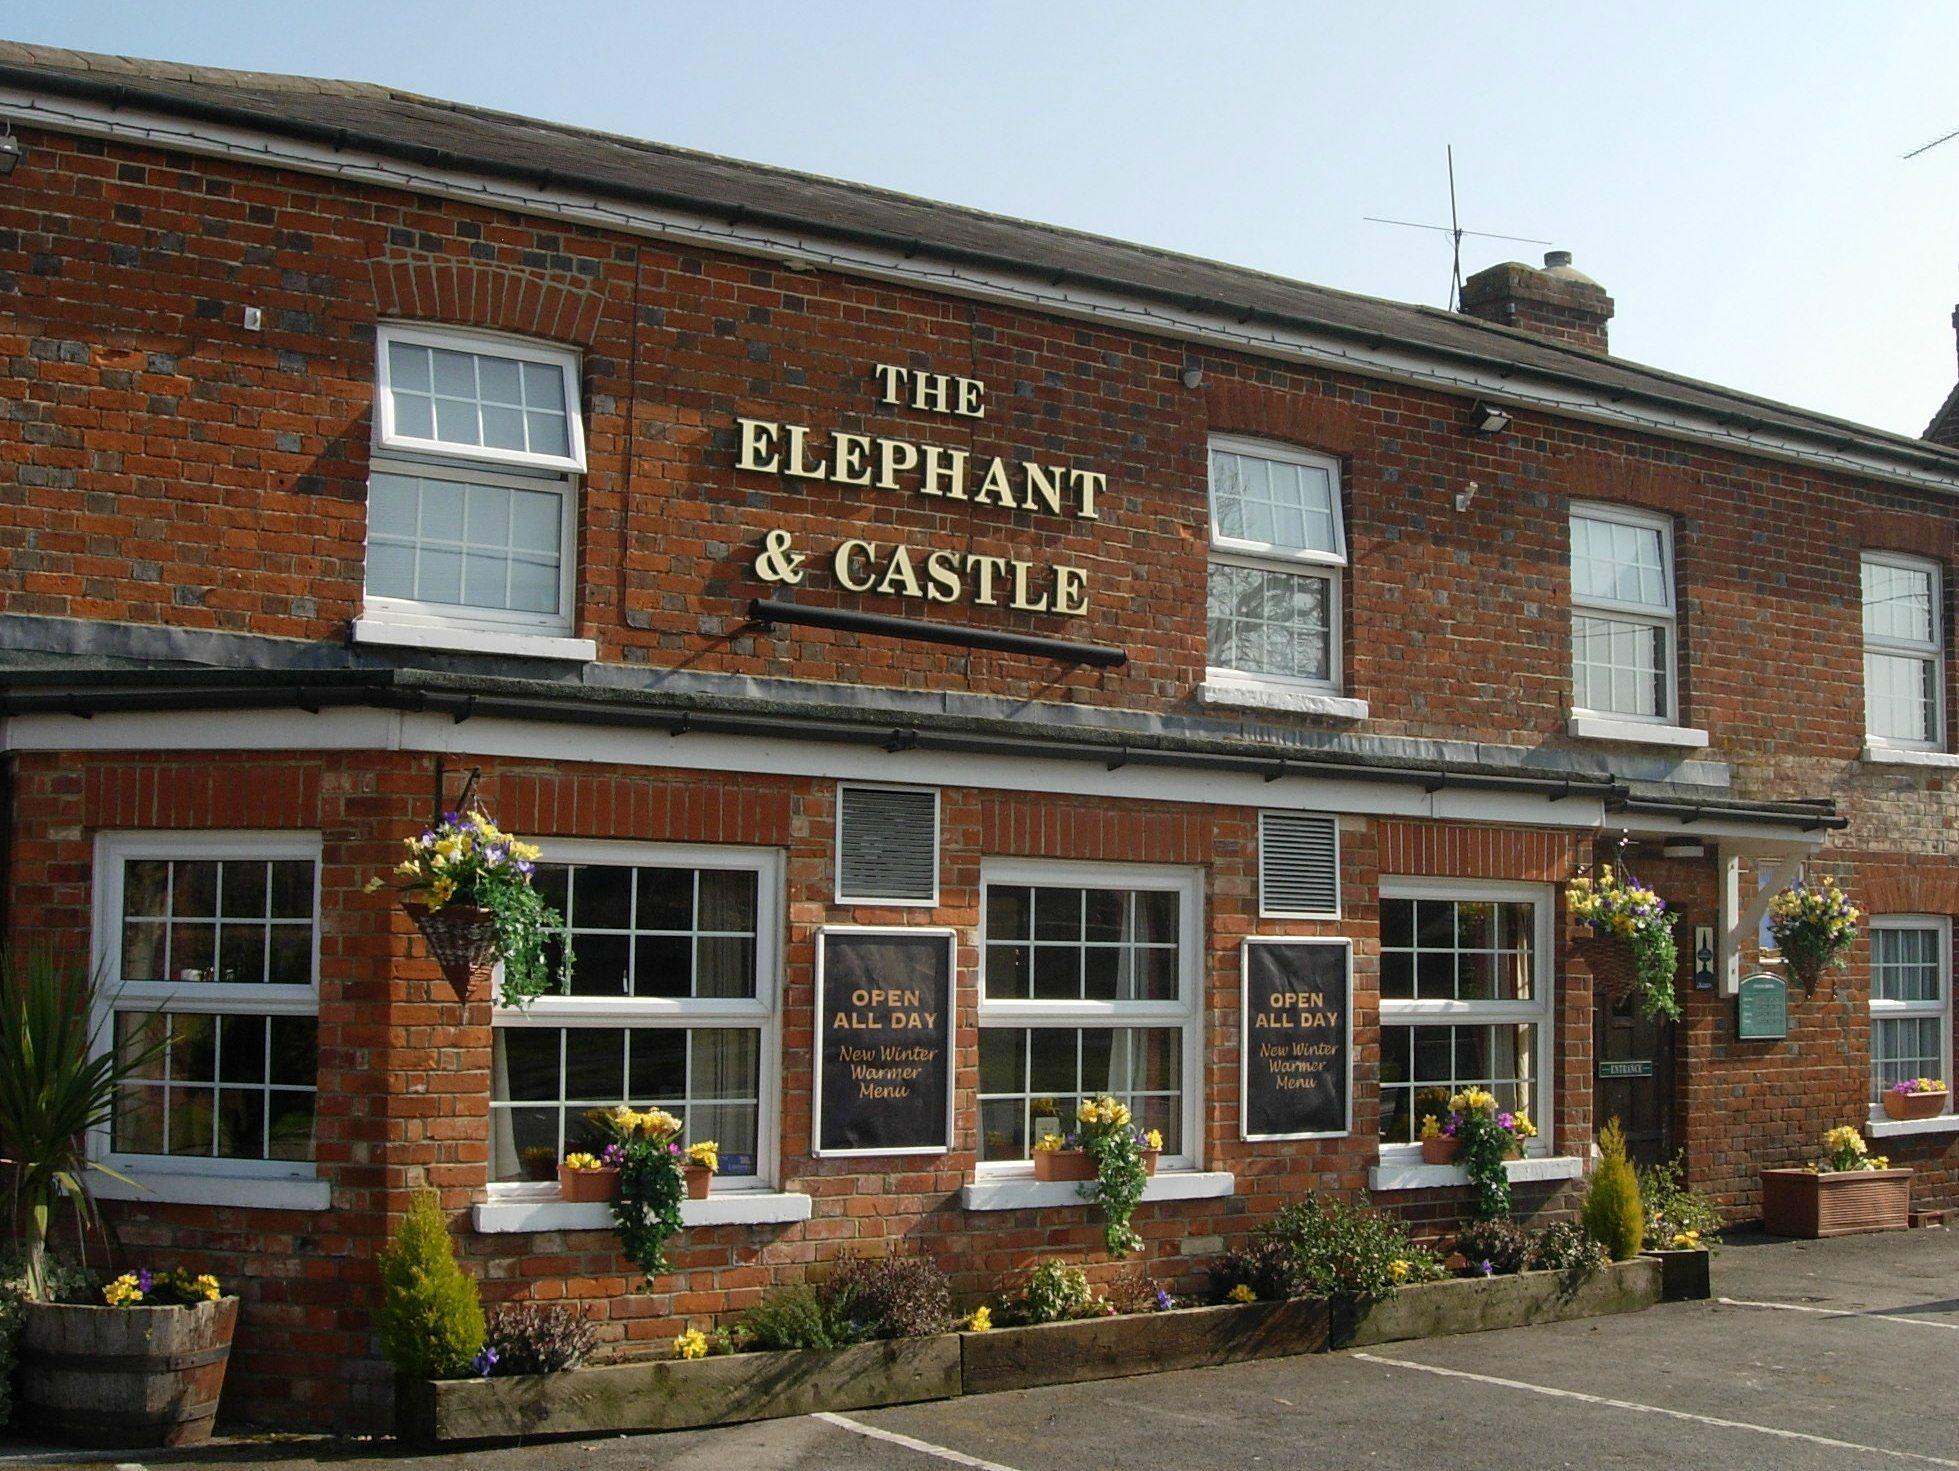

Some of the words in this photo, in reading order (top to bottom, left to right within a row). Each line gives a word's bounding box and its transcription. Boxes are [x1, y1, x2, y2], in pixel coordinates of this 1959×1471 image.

[875, 364, 985, 418] THE
[735, 417, 1107, 519] ELEPHANT
[754, 529, 806, 584] &
[834, 539, 1089, 616] CASTLE
[851, 989, 920, 1007] OPEN
[1270, 992, 1324, 1008] OPEN
[833, 1012, 882, 1029] ALL
[890, 1012, 938, 1029] DAY
[1255, 1013, 1294, 1028] ALL
[1300, 1012, 1338, 1028] DAY
[839, 1045, 876, 1062] New
[880, 1045, 938, 1062] Winter
[1259, 1042, 1289, 1058] New
[1292, 1042, 1338, 1057] Winter
[851, 1064, 922, 1081] Warmer
[1269, 1059, 1328, 1074] Warmer
[859, 1082, 909, 1099] Menu
[1276, 1076, 1317, 1090] Menu
